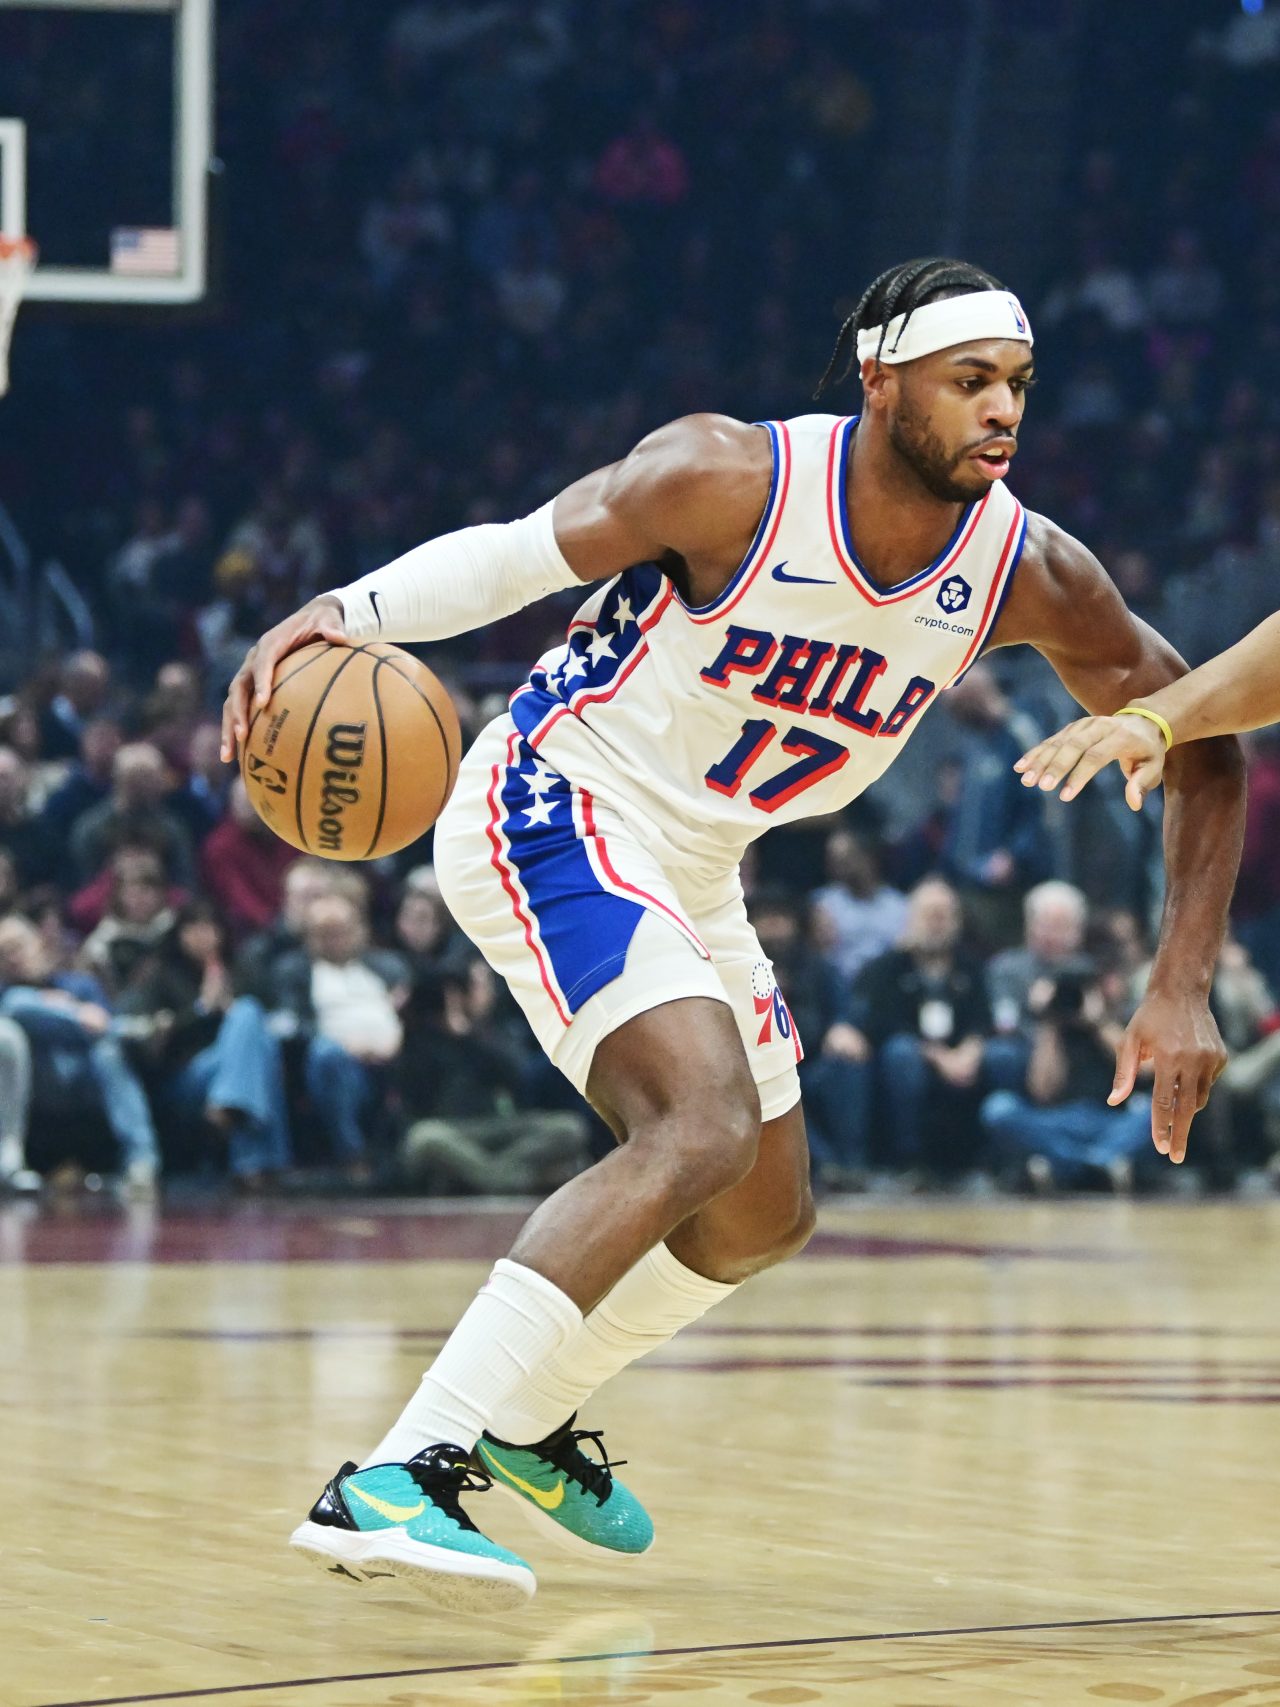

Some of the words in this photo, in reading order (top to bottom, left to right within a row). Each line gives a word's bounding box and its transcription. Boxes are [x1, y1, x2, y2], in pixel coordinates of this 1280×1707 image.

[914, 616, 975, 637] crypto.com
[699, 624, 935, 738] PHILA
[317, 721, 367, 851] Wilson
[704, 718, 851, 814] 17
[752, 985, 791, 1047] 76
